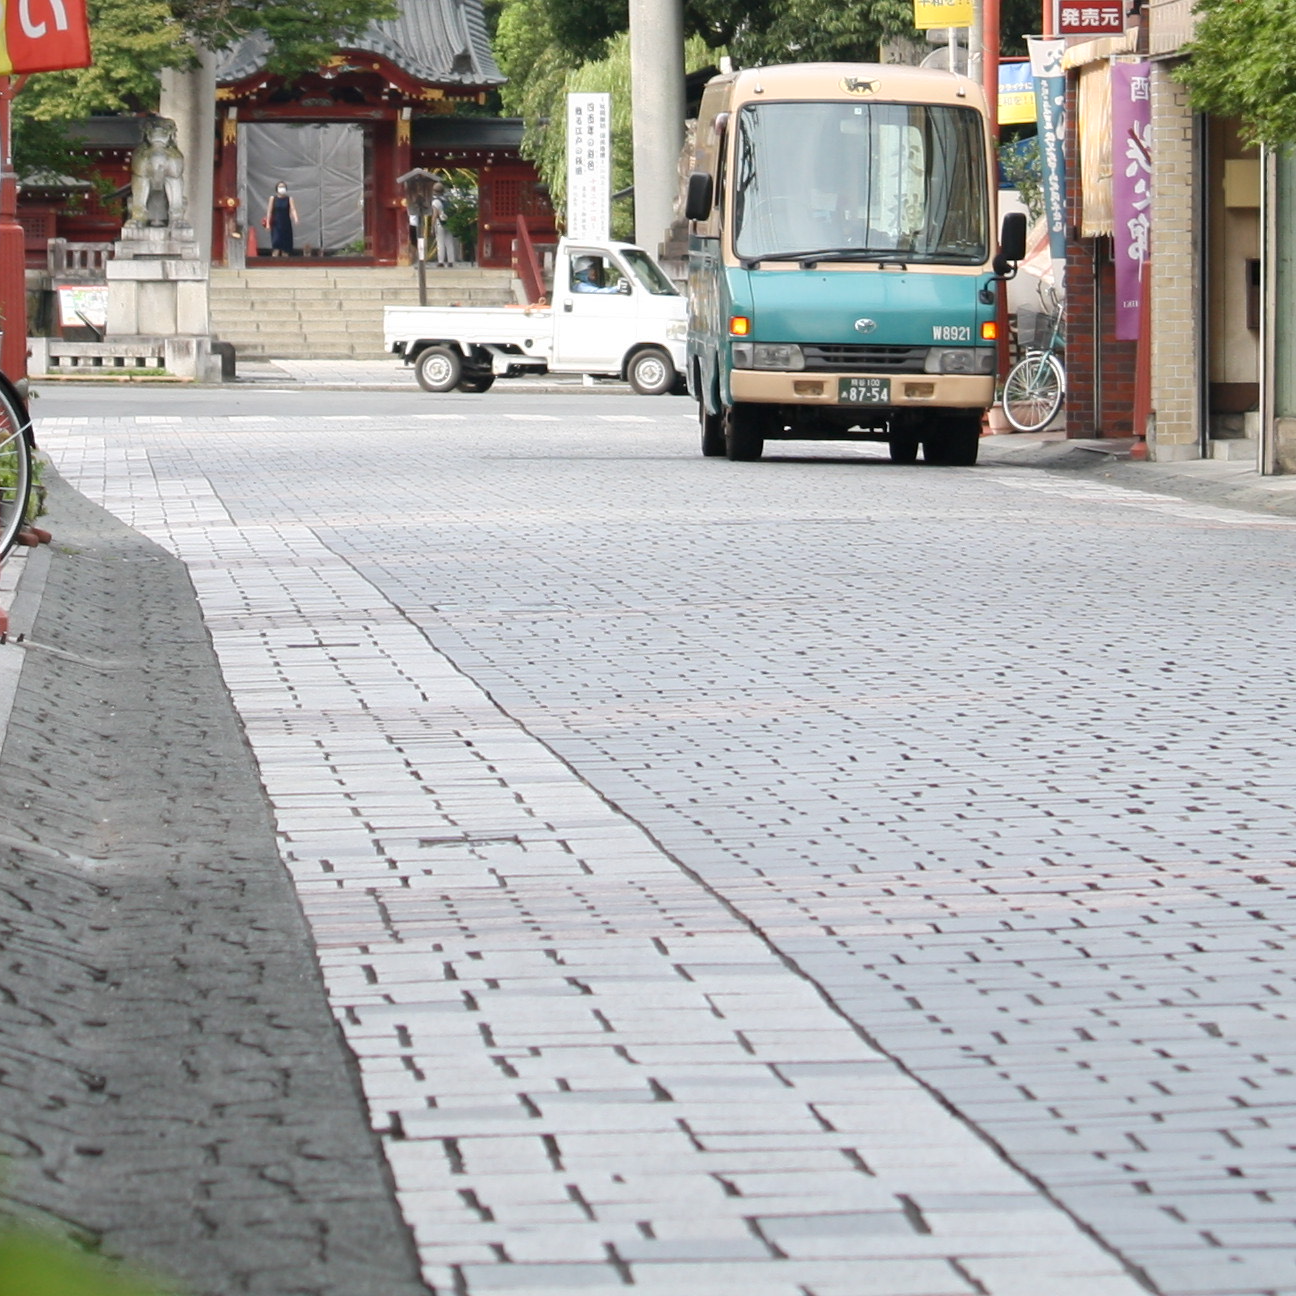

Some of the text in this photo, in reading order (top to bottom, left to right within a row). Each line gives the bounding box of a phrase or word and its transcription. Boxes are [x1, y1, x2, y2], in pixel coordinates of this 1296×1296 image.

[1061, 7, 1120, 27] 発売元
[932, 325, 971, 341] W8921
[849, 387, 889, 402] 87-54
